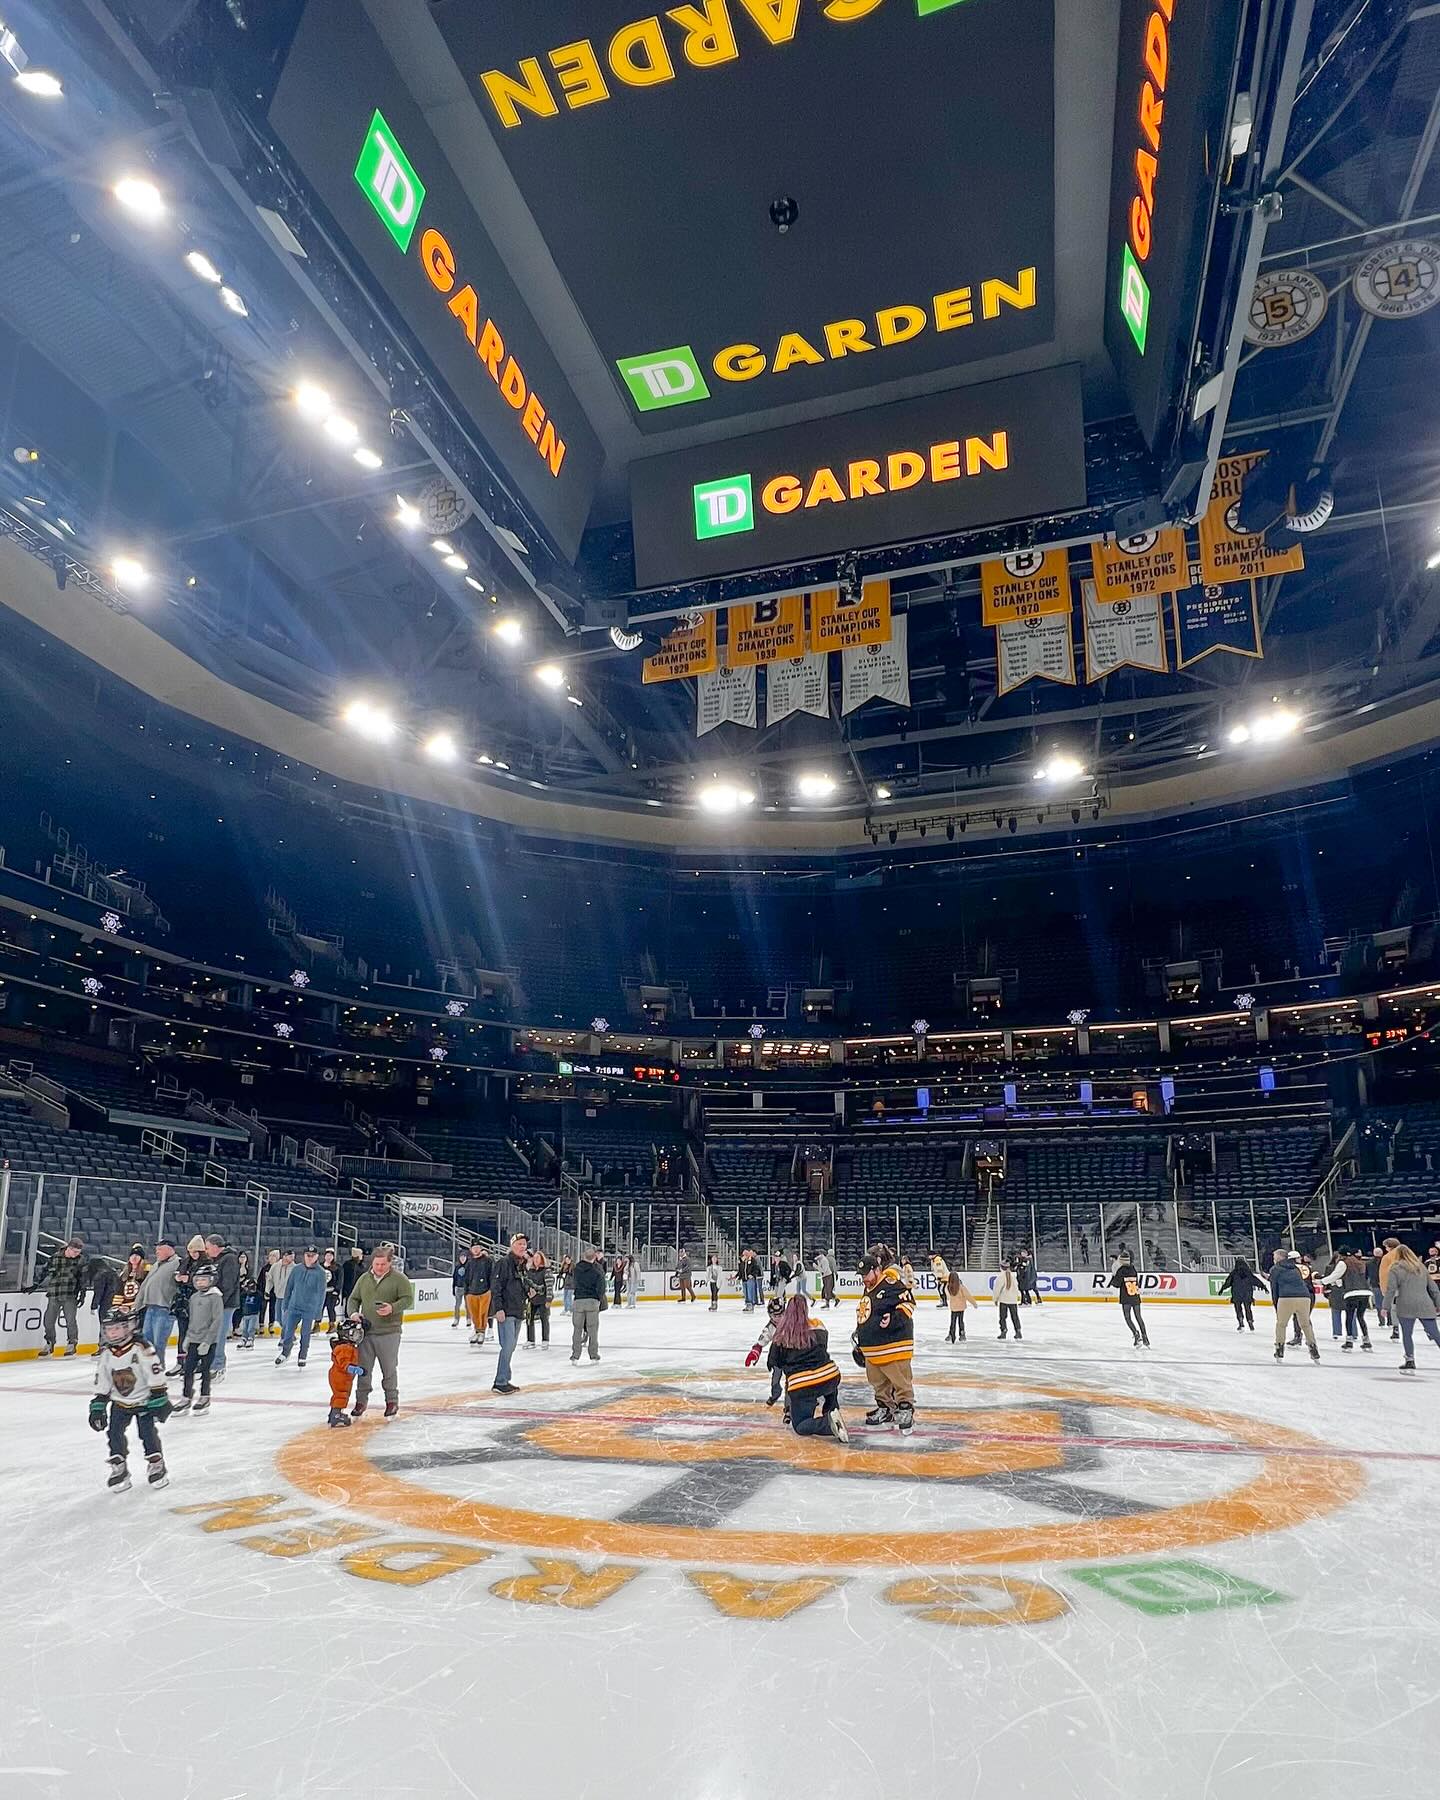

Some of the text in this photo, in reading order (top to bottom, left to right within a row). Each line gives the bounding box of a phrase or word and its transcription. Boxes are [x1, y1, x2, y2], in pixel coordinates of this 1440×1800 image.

[1278, 273, 1321, 299] CLAPPER
[1393, 268, 1415, 288] 4
[1269, 298, 1289, 319] 5
[712, 266, 1037, 382] GARDEN
[420, 228, 567, 478] GARDEN
[761, 431, 1009, 515] GARDEN
[1214, 537, 1262, 554] STANLEY
[1106, 551, 1174, 574] STANLEY CUP
[1214, 549, 1288, 567] CHAMPIONS
[1106, 564, 1176, 587] CHAMPIONS
[1239, 562, 1265, 575] 2011
[993, 575, 1058, 596] STANLEY CUP
[1130, 580, 1156, 594] 1972
[993, 587, 1060, 608] CHAMPIONS
[820, 607, 880, 626] STANLEY CUP
[1015, 603, 1040, 616] 1970
[738, 623, 794, 641] STANLEY CUP
[820, 619, 881, 638] CHAMPIONS
[661, 638, 706, 654] ANLEY CUP
[737, 634, 795, 652] CHAMPIONS
[840, 634, 861, 645] 1941
[651, 649, 707, 667] CHAMPIONS
[755, 649, 777, 661] 1939
[669, 664, 690, 675] 1929
[612, 1067, 624, 1075] PM
[693, 1279, 708, 1288] PP
[839, 1277, 864, 1287] Bank
[1092, 1274, 1177, 1289] RAID7
[418, 1287, 440, 1302] Bank
[131, 1353, 139, 1364] A
[167, 1493, 1073, 1627] GARDEN
